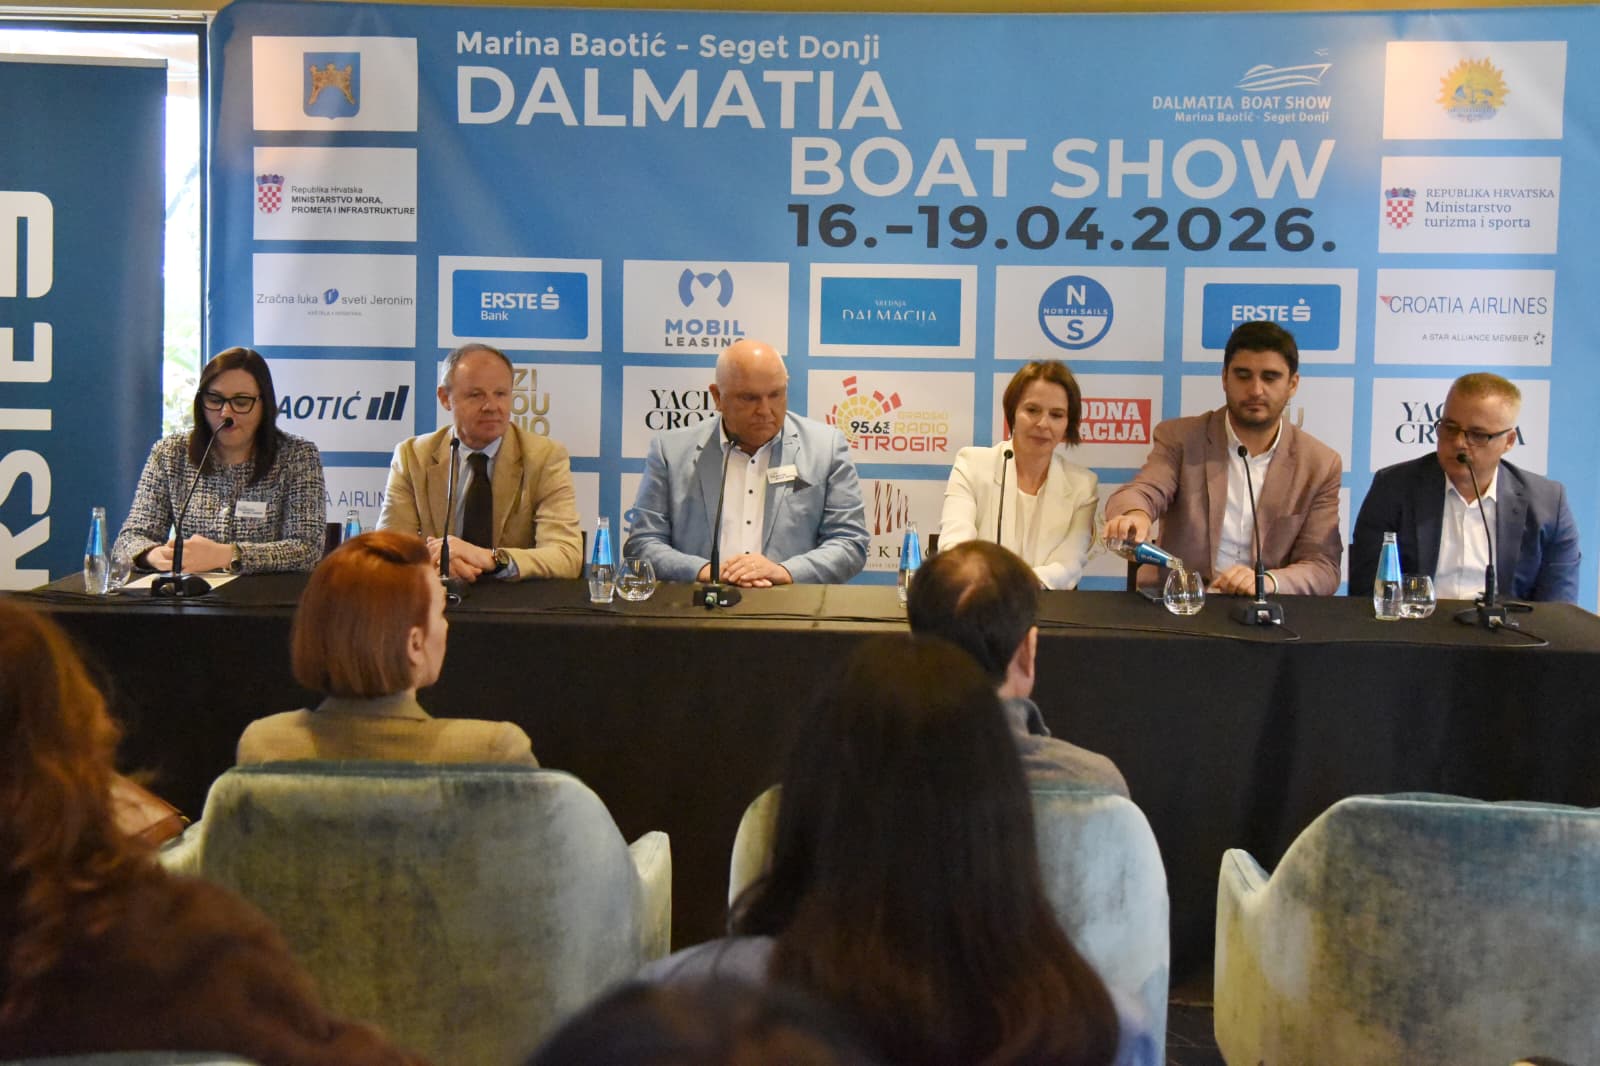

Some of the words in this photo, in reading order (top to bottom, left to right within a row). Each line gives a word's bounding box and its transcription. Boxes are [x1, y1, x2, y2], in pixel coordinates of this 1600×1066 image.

[457, 31, 559, 55] Marina
[571, 31, 666, 57] Baotić
[699, 34, 789, 64] Seget
[800, 34, 880, 65] Donji
[457, 65, 902, 130] DALMATIA
[1152, 95, 1234, 110] DALMATIA
[1241, 95, 1281, 110] BOAT
[1285, 95, 1332, 110] SHOW
[1175, 111, 1214, 122] Marina
[1263, 111, 1296, 124] Seget
[1299, 111, 1329, 124] Donji
[790, 136, 1027, 198] BOAT
[1050, 138, 1337, 200] SHOW
[291, 186, 329, 195] Republika
[331, 186, 363, 194] Hrvatska
[1426, 188, 1490, 198] REPUBLIKA
[1493, 188, 1555, 198] HRVATSKA
[291, 196, 352, 204] MINISTARSTVO
[355, 196, 383, 204] MORA,
[291, 206, 333, 214] PROMETA
[334, 206, 337, 214] I
[338, 206, 416, 215] INFRASTRUKTURE
[1425, 201, 1512, 213] Ministarstvo
[1424, 216, 1477, 228] turizma
[1481, 216, 1485, 228] i
[1488, 216, 1531, 230] sporta
[256, 293, 294, 305] Zračna
[297, 294, 318, 304] luka
[341, 294, 367, 305] sveti
[370, 295, 414, 305] Jeronim
[481, 292, 538, 310] ERSTE
[1067, 284, 1086, 305] N
[1389, 296, 1464, 314] CROATIA
[1469, 296, 1548, 315] AIRLINES
[481, 310, 509, 321] Bank
[842, 309, 937, 321] DALMACIJA
[1232, 305, 1288, 321] ERSTE
[665, 319, 745, 336] MOBIL
[1067, 319, 1084, 340] S
[665, 337, 744, 347] LEASIN
[1429, 333, 1449, 341] STAR
[1451, 333, 1490, 342] ALLIANCE
[1491, 334, 1529, 342] MEMBER
[851, 421, 882, 434] 95.6
[883, 421, 890, 434] FM
[894, 422, 949, 434] RADIO
[859, 435, 948, 452] TROGIR
